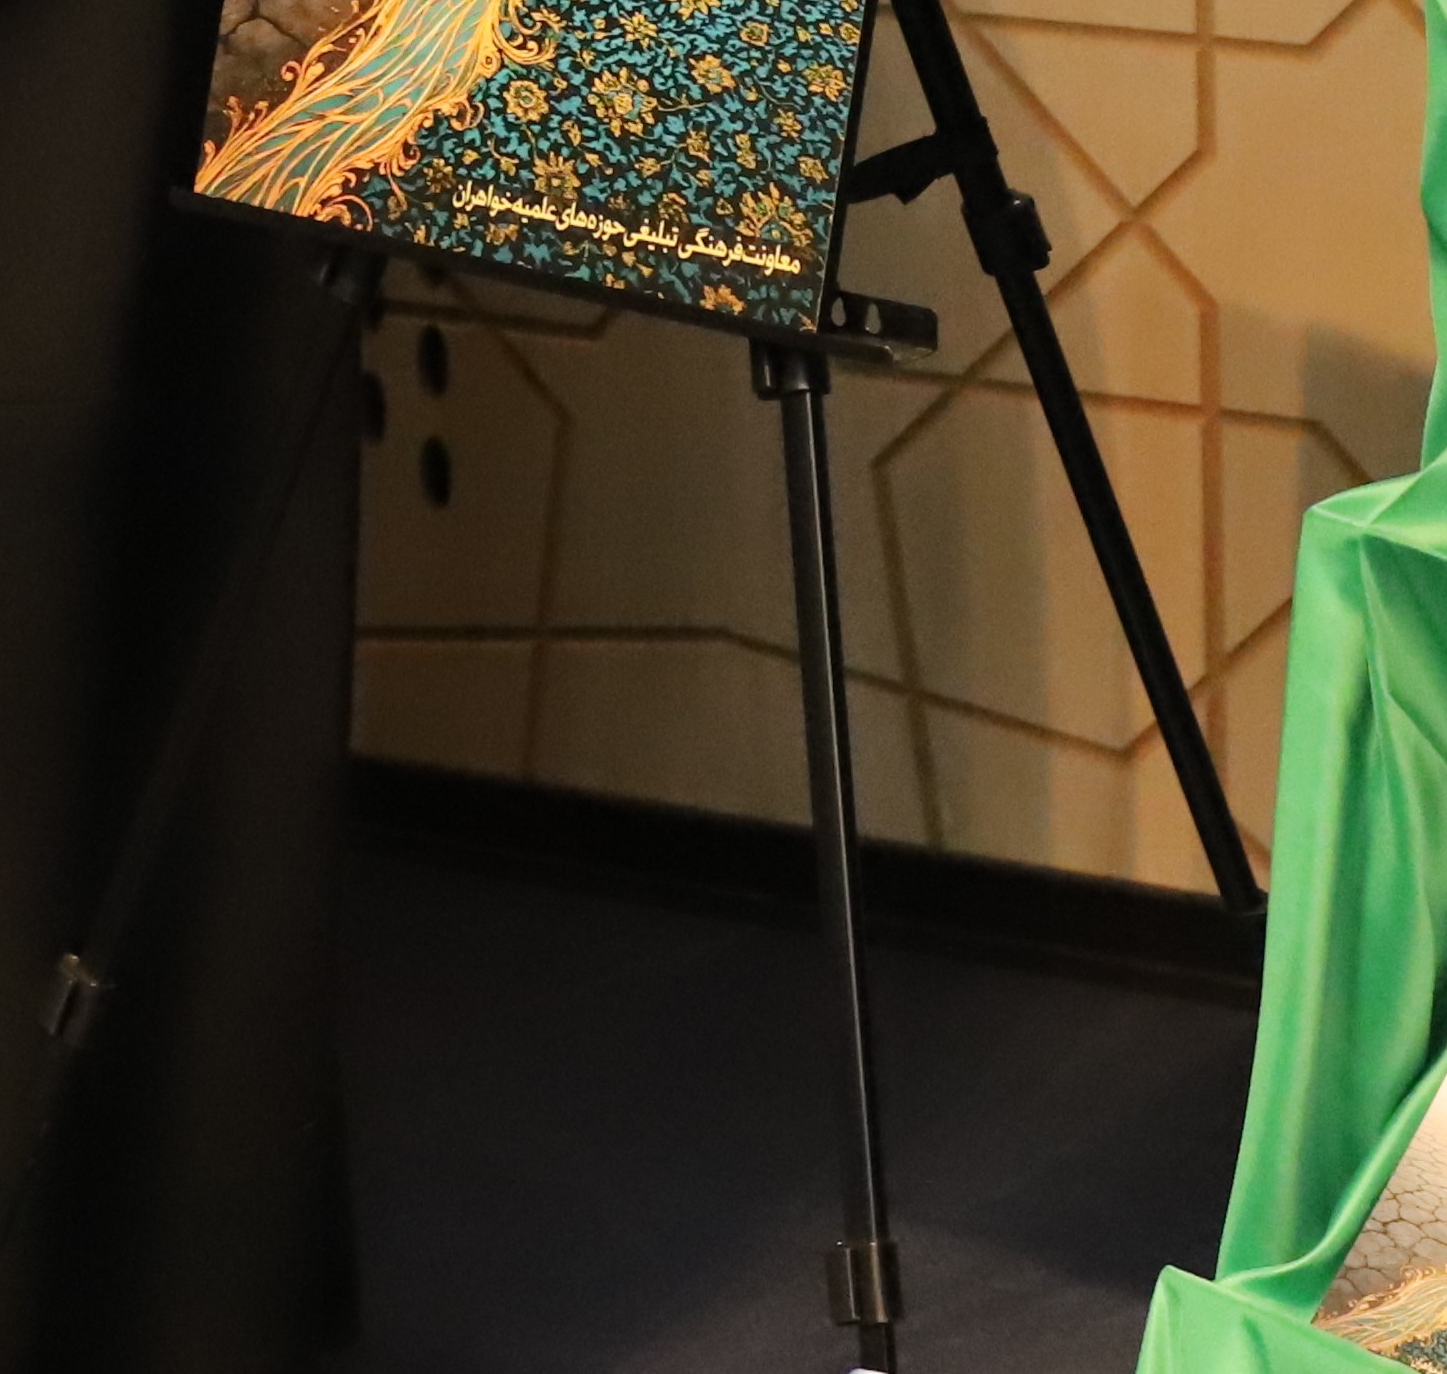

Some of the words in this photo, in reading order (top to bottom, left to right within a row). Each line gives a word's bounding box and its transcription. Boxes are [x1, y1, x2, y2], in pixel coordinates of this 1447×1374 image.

[451, 180, 512, 217] خواهران
[511, 196, 558, 223] علمیه
[622, 218, 680, 253] تبلیغی
[677, 227, 744, 266] فرهنگی
[741, 243, 801, 276] معاونت
